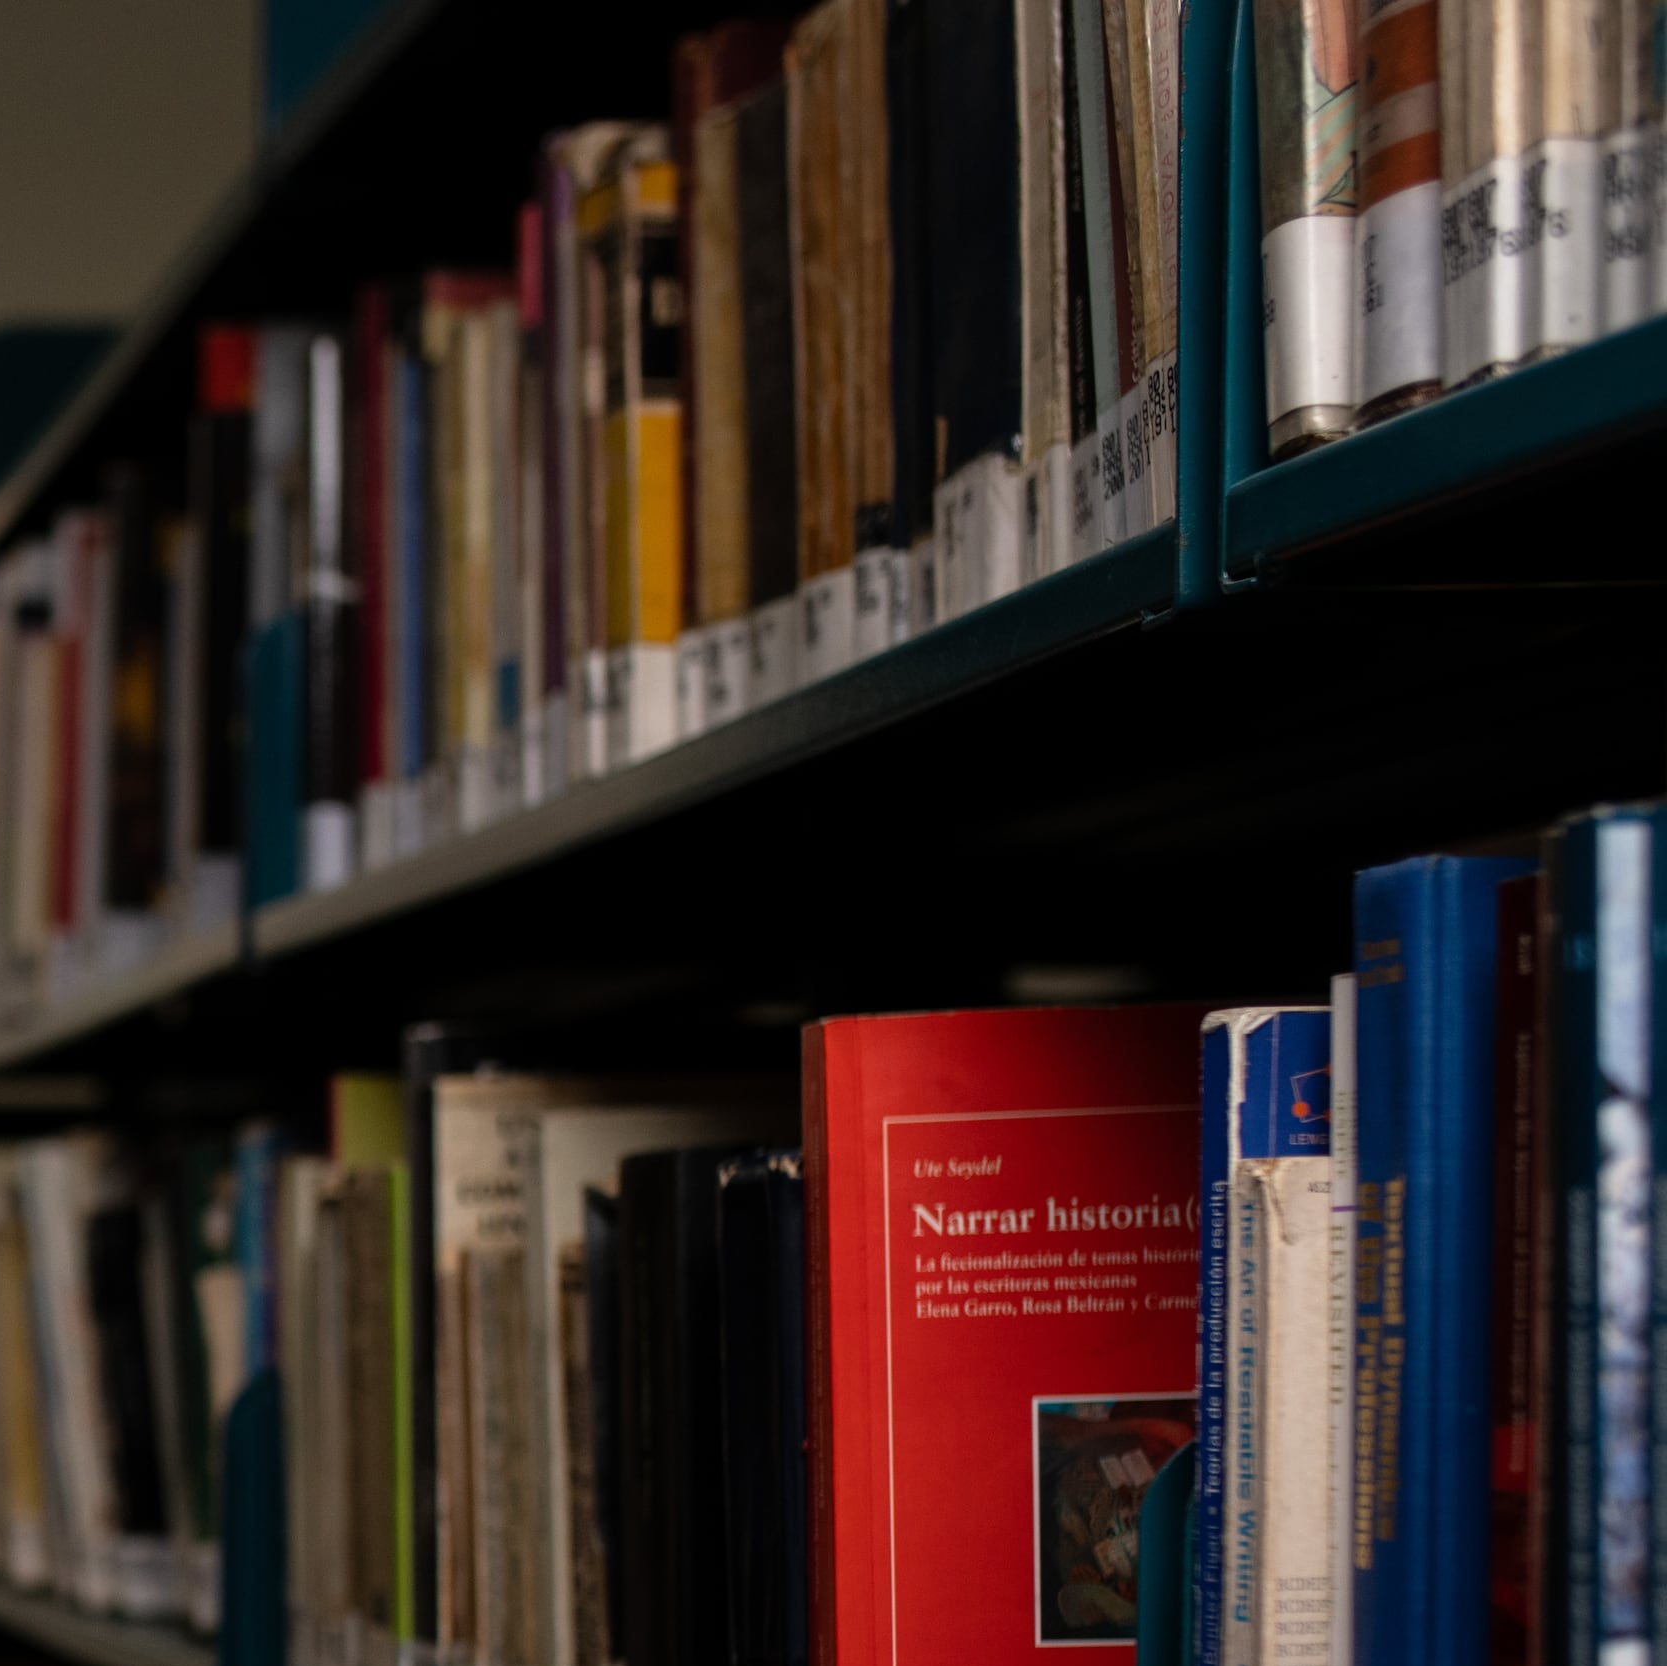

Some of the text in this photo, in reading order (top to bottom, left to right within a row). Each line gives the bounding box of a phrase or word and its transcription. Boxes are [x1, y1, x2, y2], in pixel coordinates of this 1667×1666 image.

[1160, 150, 1175, 234] NOVA
[913, 1155, 1003, 1180] Ute Seydel
[912, 1202, 1035, 1238] Narrar
[1207, 1181, 1229, 1250] escrita
[916, 1245, 1201, 1273] La ficcionalización de temas históric
[1383, 1175, 1406, 1326] Textual
[916, 1272, 1137, 1299] por las escritoras mexicanas
[1239, 1259, 1258, 1297] Art
[916, 1299, 960, 1319] Elena
[964, 1298, 1017, 1319] Garro,
[1022, 1297, 1062, 1315] Rosa
[1067, 1294, 1125, 1314] Beltrán
[1145, 1292, 1201, 1311] Carme
[1204, 1255, 1227, 1364] producción
[1239, 1306, 1258, 1335] of
[1205, 1371, 1223, 1388] la
[1205, 1395, 1223, 1418] de
[1233, 1510, 1257, 1624] Writing
